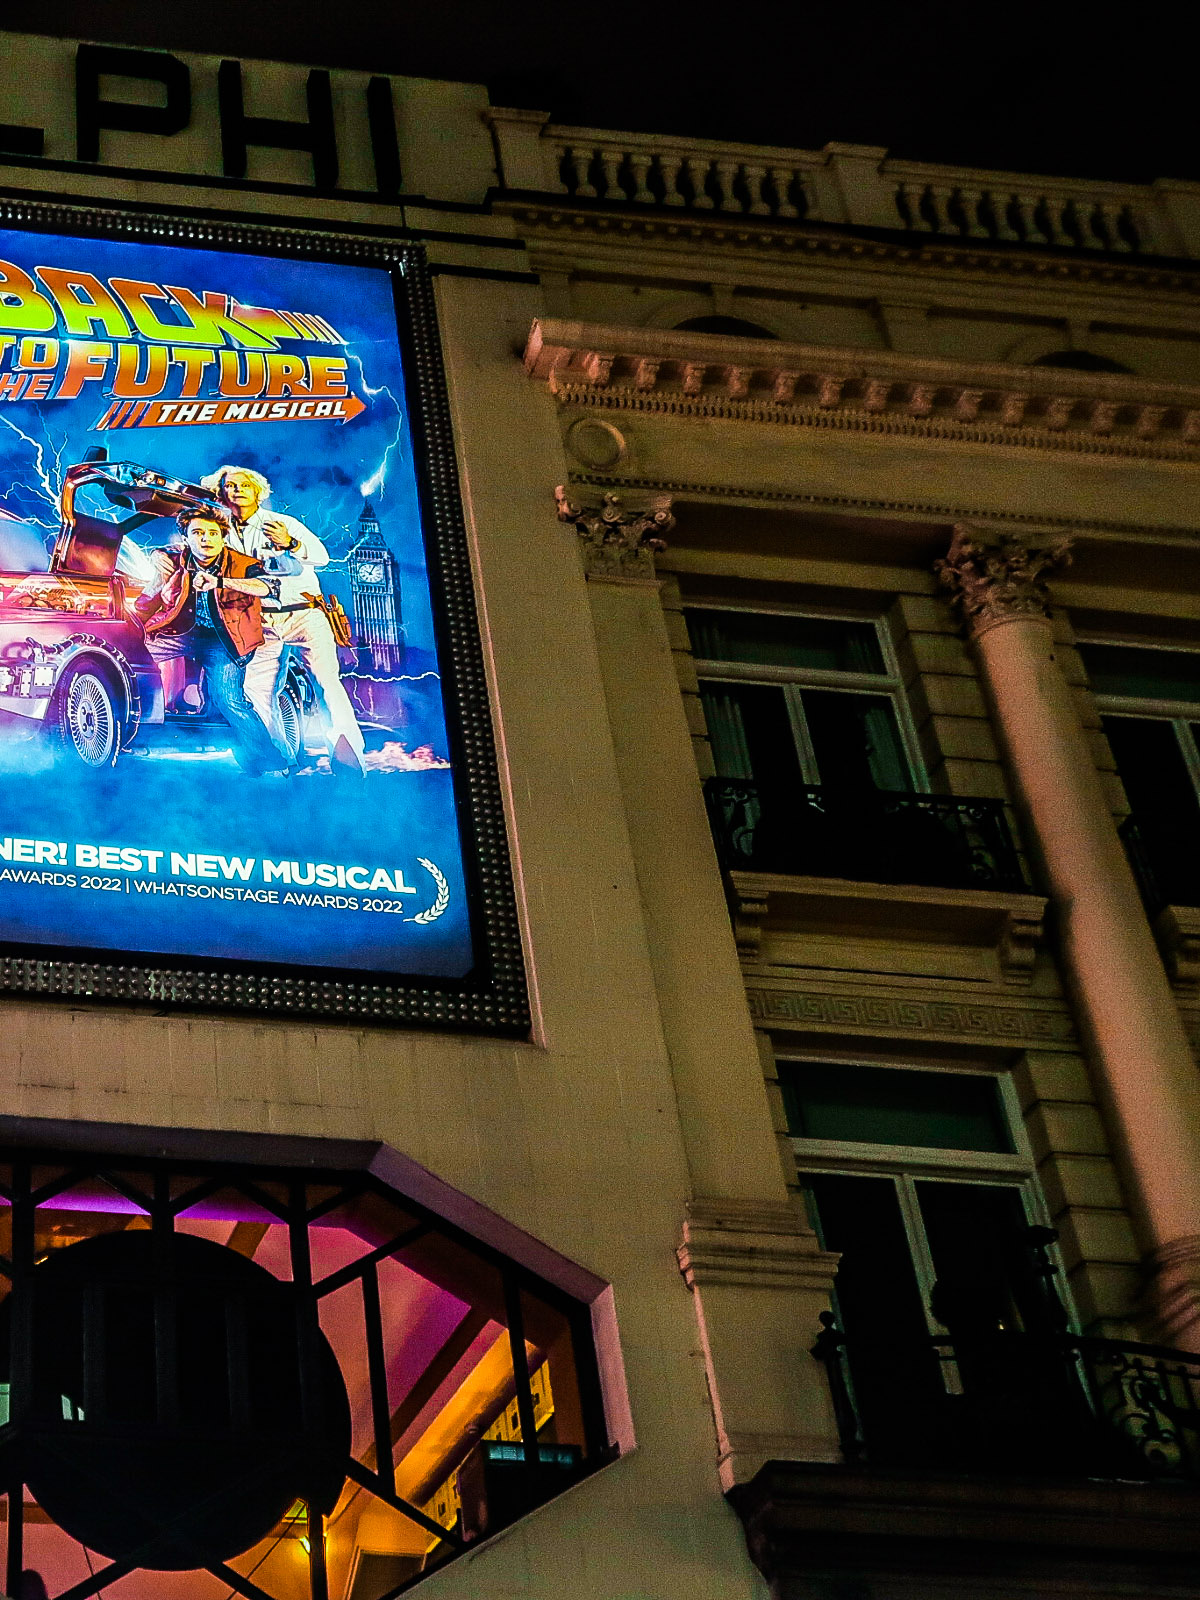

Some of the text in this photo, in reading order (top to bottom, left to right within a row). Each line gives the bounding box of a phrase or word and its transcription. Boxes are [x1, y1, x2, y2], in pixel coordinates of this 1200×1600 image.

[55, 338, 348, 399] FUTURE
[157, 401, 346, 423] THE MUSICAL
[0, 868, 77, 887] AWARDS
[80, 876, 122, 892] 2022
[133, 880, 279, 905] WHATSONSTAGE
[283, 892, 359, 911] AWARDS
[362, 899, 403, 914] 2022
[75, 844, 163, 875] BEST
[170, 852, 255, 881] NEW
[262, 860, 417, 894] MUSICAL
